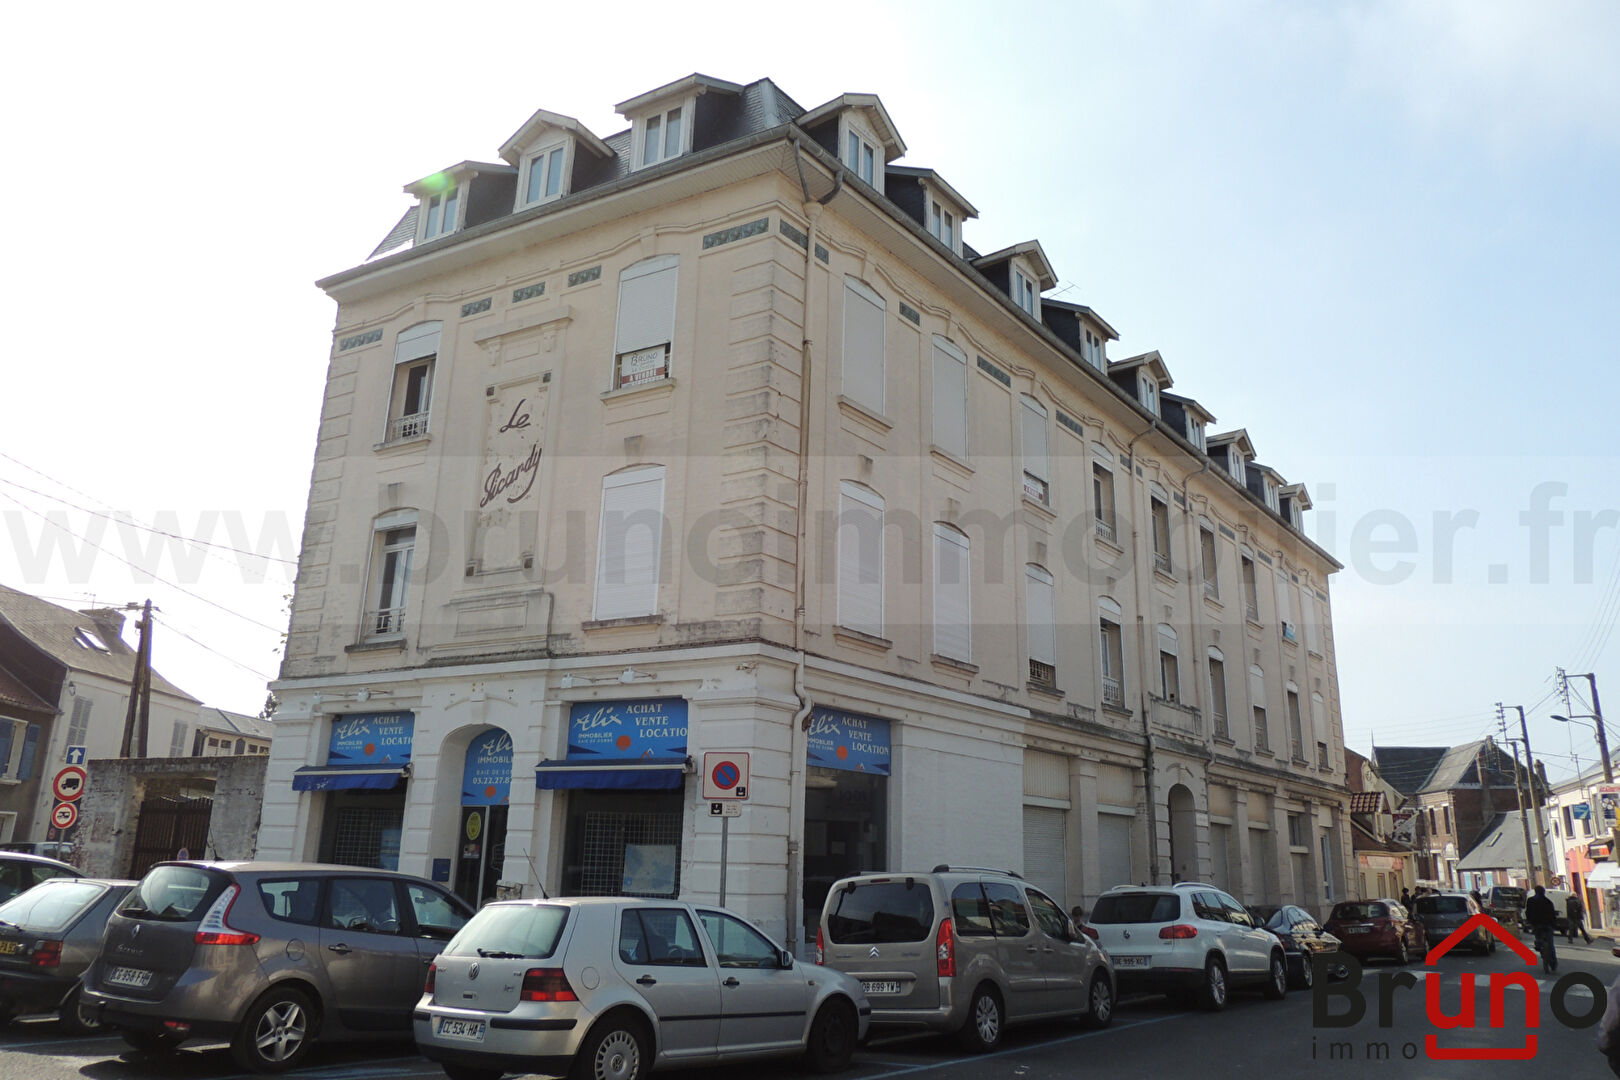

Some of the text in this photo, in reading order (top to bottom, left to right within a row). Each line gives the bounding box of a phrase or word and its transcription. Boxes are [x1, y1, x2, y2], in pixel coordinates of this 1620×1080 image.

[499, 399, 531, 433] Le
[480, 443, 542, 508] Picardy
[626, 704, 662, 714] ACHAT
[373, 716, 400, 724] ACHAT
[574, 706, 622, 731] Alix
[635, 716, 669, 726] VENTE
[842, 716, 868, 729] ACHAT
[335, 718, 370, 739] Alix
[379, 727, 403, 735] VENTE
[849, 730, 872, 742] VENTE
[852, 742, 889, 755] LOCATION
